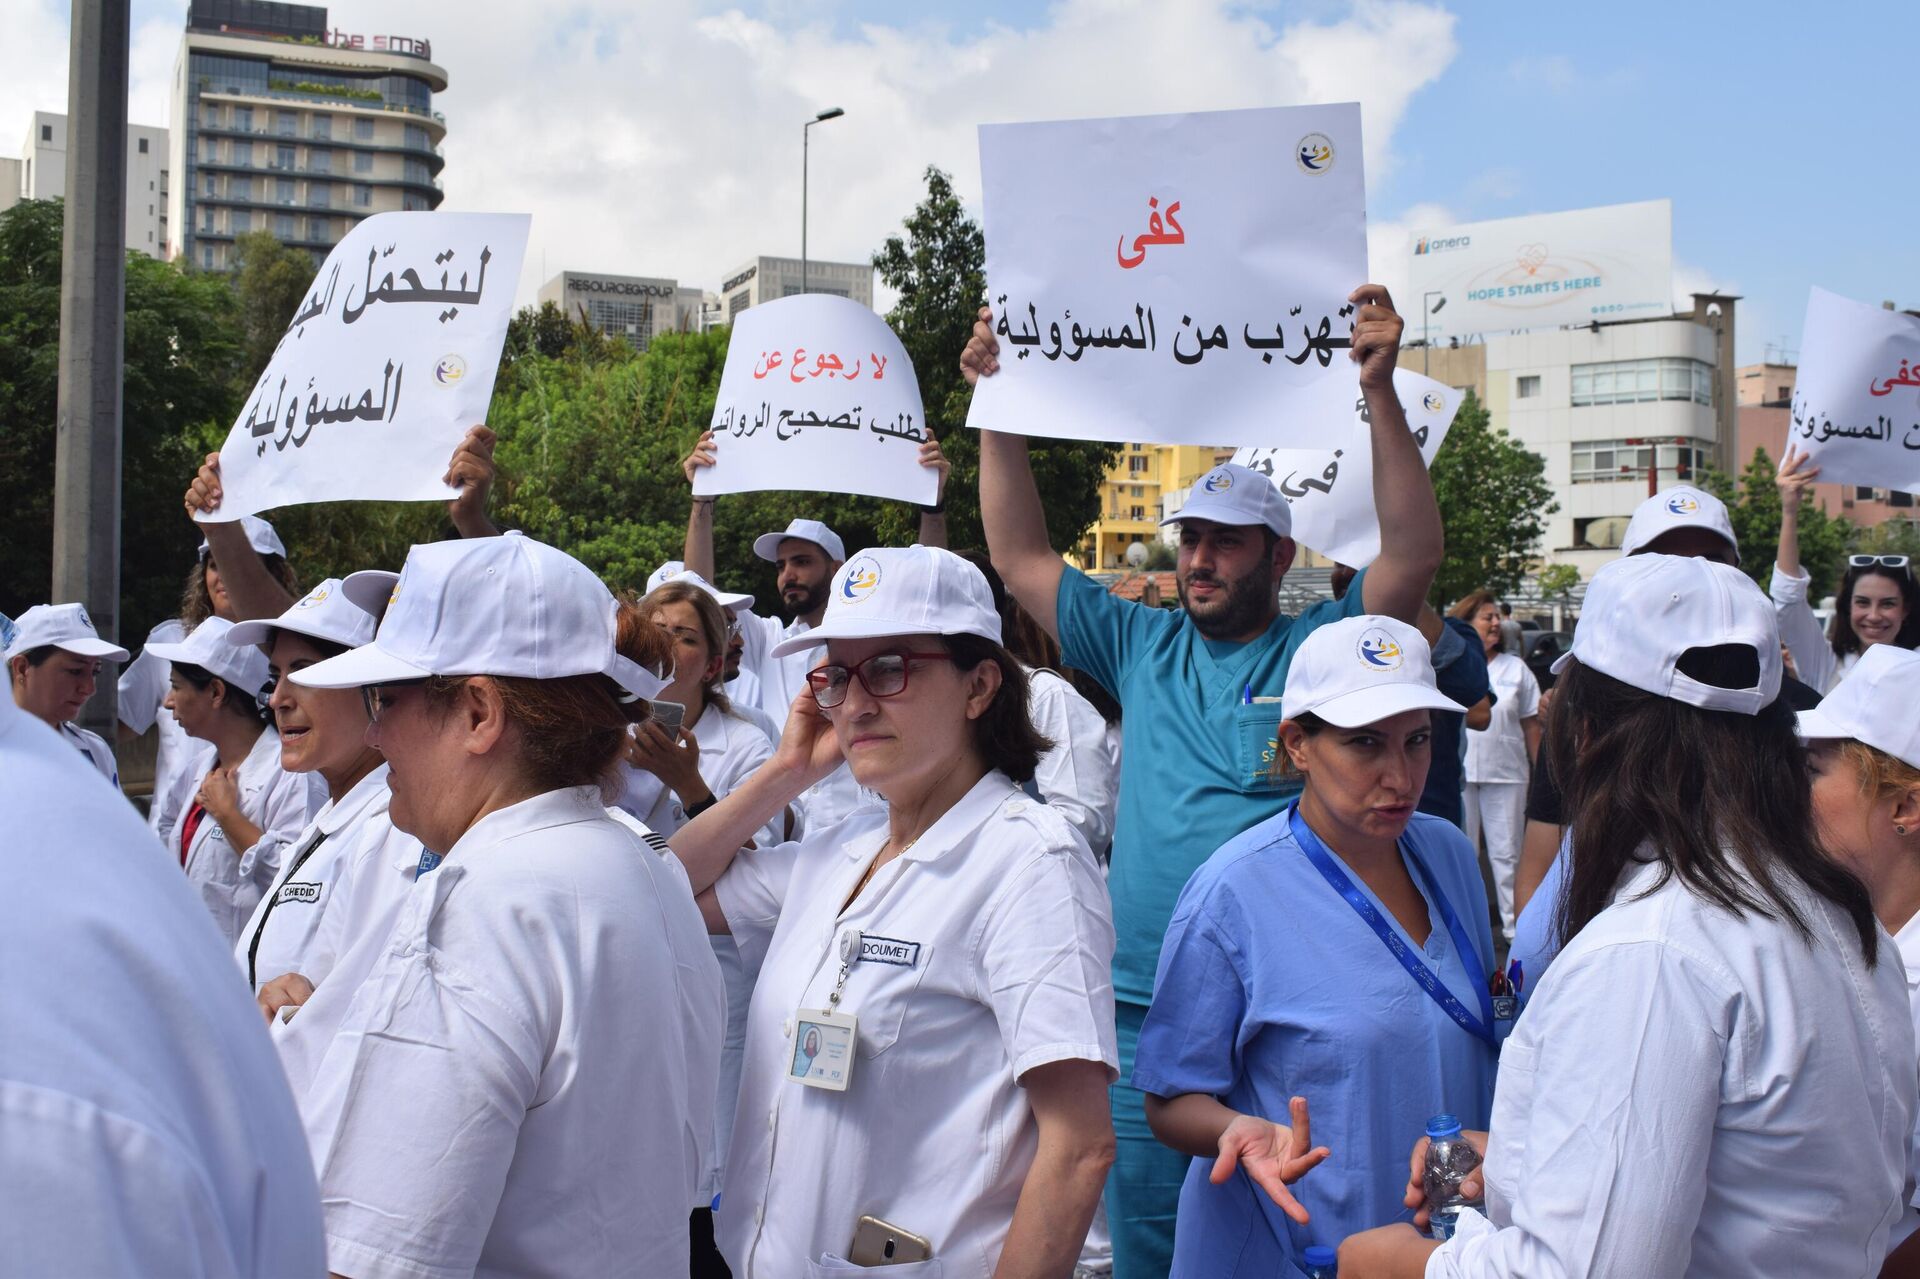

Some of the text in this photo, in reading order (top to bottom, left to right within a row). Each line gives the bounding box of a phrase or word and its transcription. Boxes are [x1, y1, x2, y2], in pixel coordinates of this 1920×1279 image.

[1118, 196, 1185, 269] كفى
[1431, 236, 1470, 250] anera
[1468, 276, 1601, 301] HOPE STARTS HERE
[997, 294, 1156, 363] المسؤولية
[1173, 314, 1229, 365] من
[753, 348, 888, 383] لا رجوع عن
[777, 405, 862, 441] تصحيح
[1280, 449, 1344, 503] في
[284, 887, 316, 897] CHEDID
[862, 943, 910, 959] DOUMET
